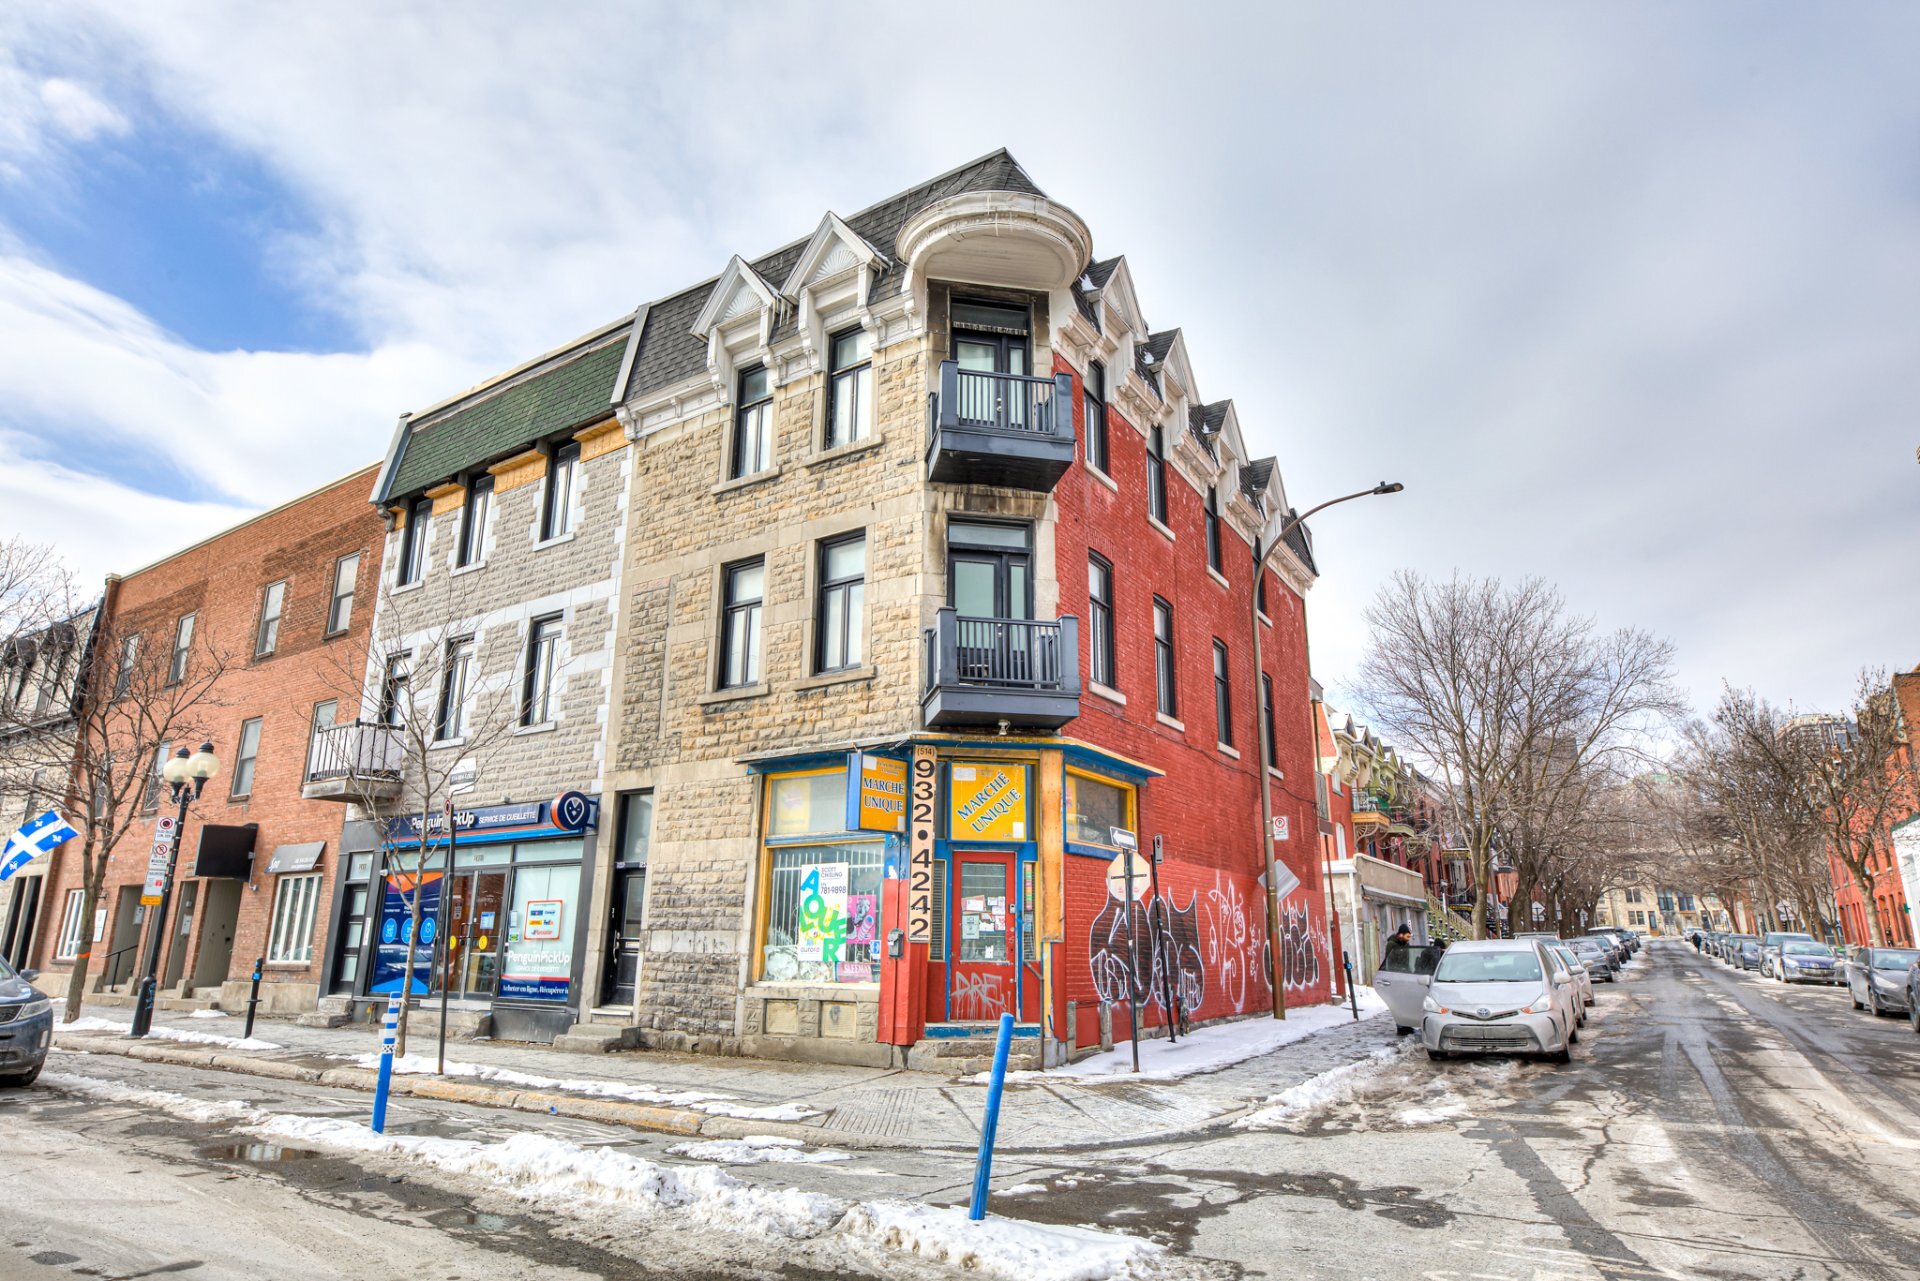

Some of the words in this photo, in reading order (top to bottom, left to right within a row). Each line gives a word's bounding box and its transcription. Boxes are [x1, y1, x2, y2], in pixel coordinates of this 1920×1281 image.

[917, 747, 935, 756] (514)
[863, 777, 905, 795] MARCHÉ
[957, 769, 1010, 820] MARCHÉ
[864, 795, 903, 812] UNIQUE
[971, 788, 1021, 832] UNIQUE
[478, 815, 498, 825] SERVICE
[499, 814, 506, 822] DE
[506, 810, 537, 821] CUEILLETTE
[800, 866, 820, 895] À
[821, 885, 847, 894] 781-9898
[508, 950, 570, 966] PenguinPickUp
